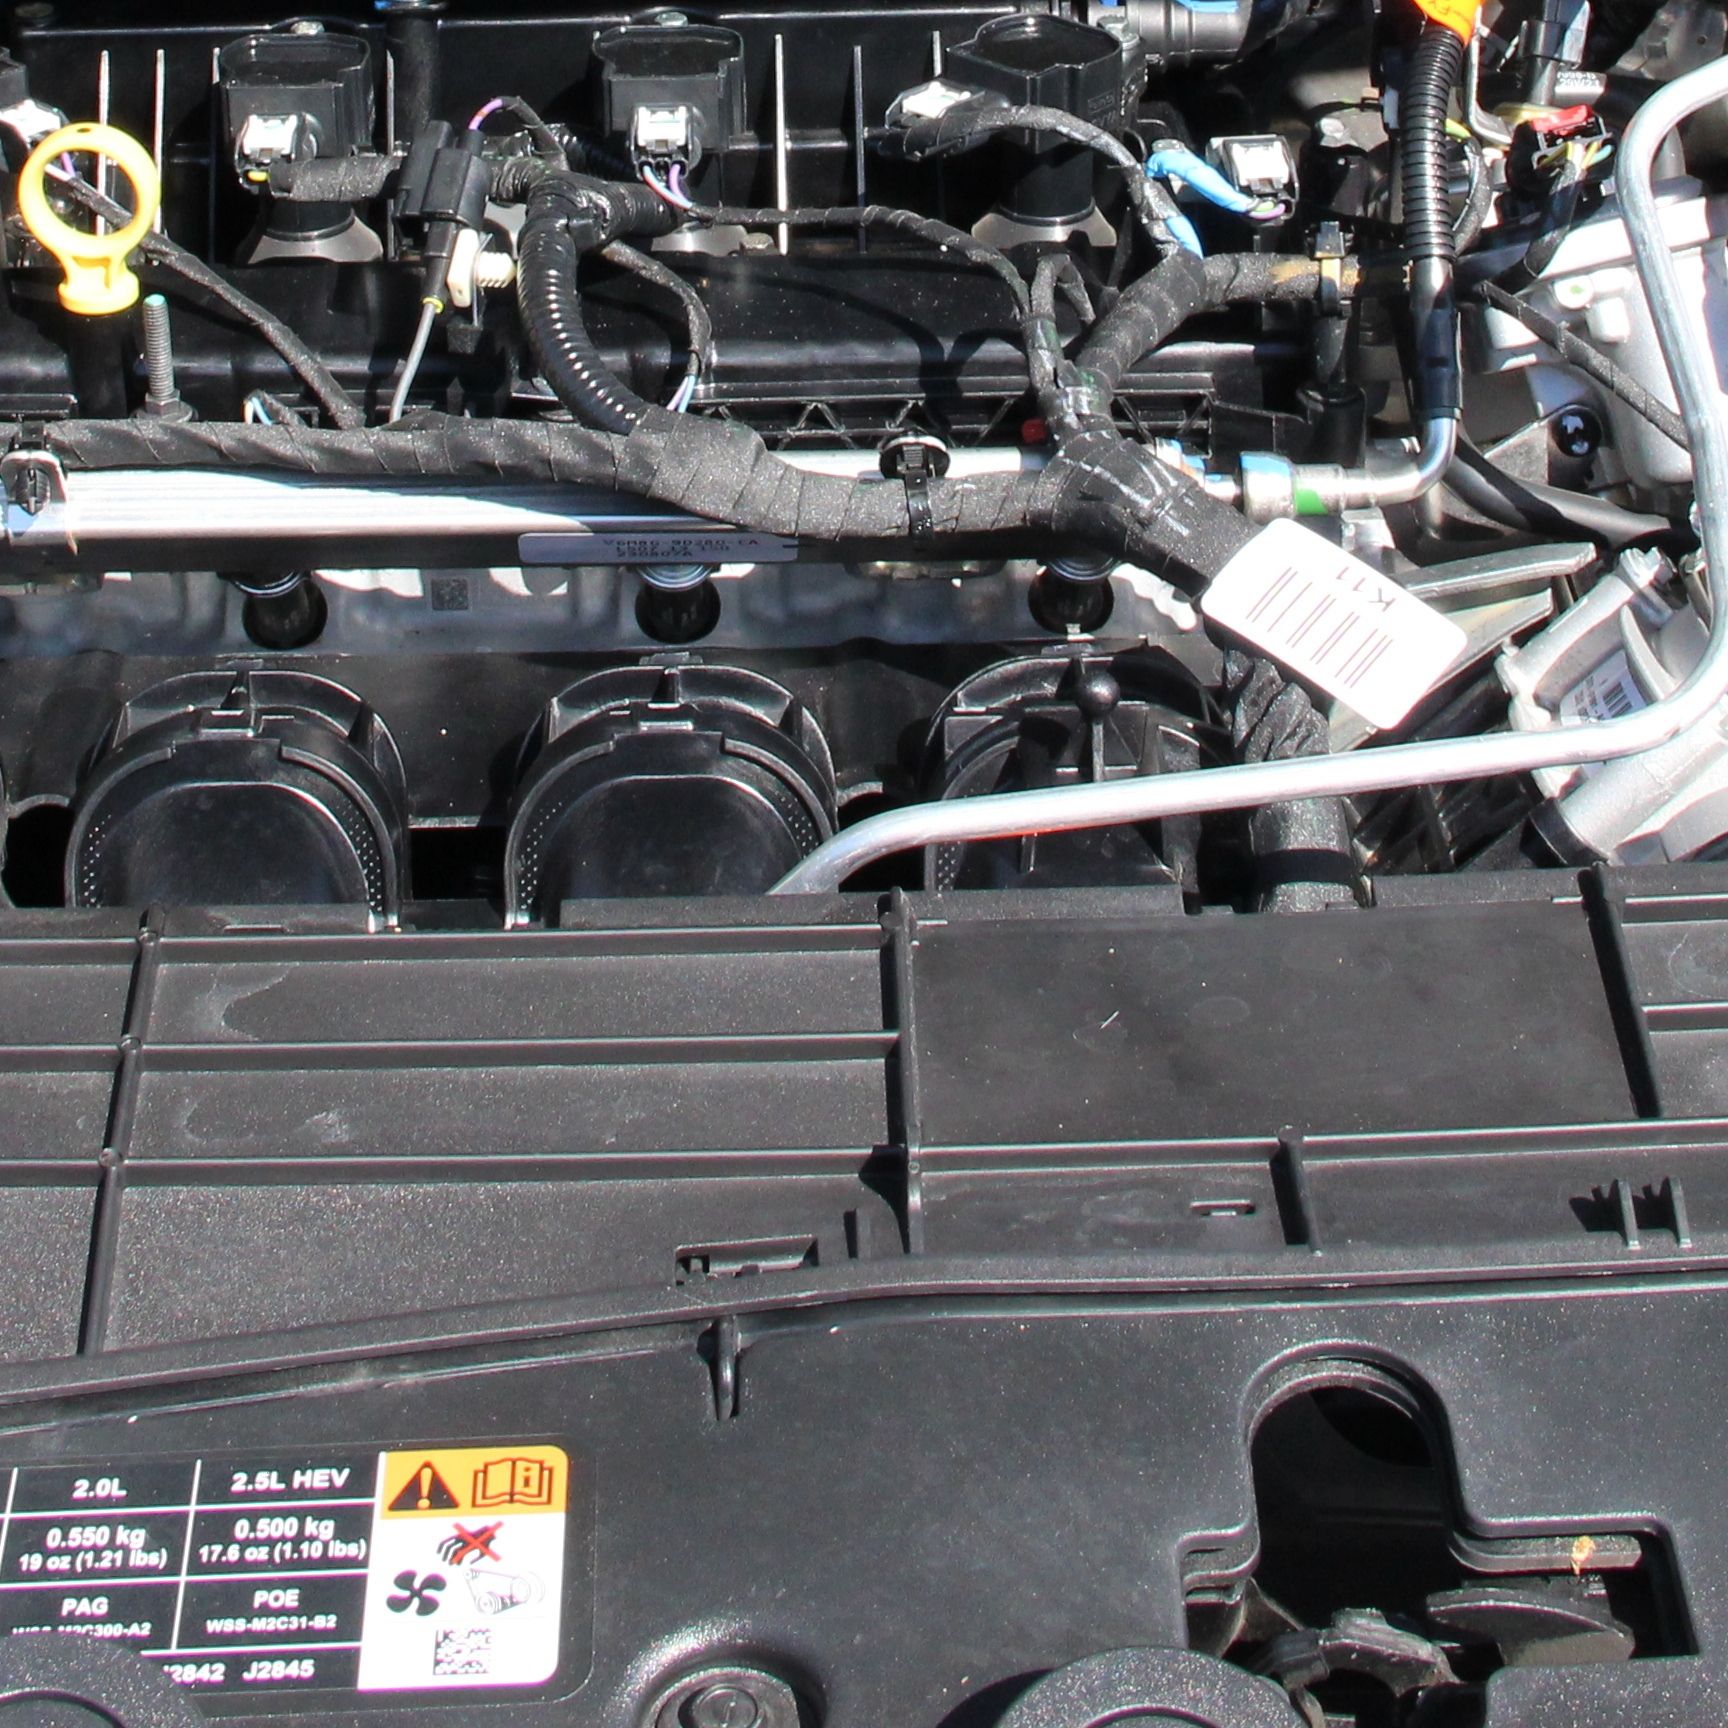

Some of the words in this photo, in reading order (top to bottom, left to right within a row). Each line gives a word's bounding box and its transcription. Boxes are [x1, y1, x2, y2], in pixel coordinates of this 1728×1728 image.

[72, 1478, 127, 1499] 2.0L
[230, 1471, 286, 1493] 2.5L
[293, 1468, 350, 1489] HEV
[46, 1527, 111, 1549] 0.550
[116, 1526, 146, 1549] kg
[234, 1518, 300, 1540] 0.500
[305, 1516, 335, 1540] kg
[19, 1553, 43, 1572] 19
[47, 1555, 70, 1571] oz
[75, 1551, 123, 1572] (1.21
[129, 1548, 168, 1571] lbs)
[199, 1544, 241, 1563] 17.6
[245, 1546, 269, 1561] oz
[273, 1541, 323, 1564] (1.10
[328, 1539, 366, 1561] lbs)
[61, 1597, 109, 1617] PAG
[254, 1589, 300, 1609] POE
[163, 1663, 226, 1683] 2842
[242, 1660, 315, 1681] J2845
